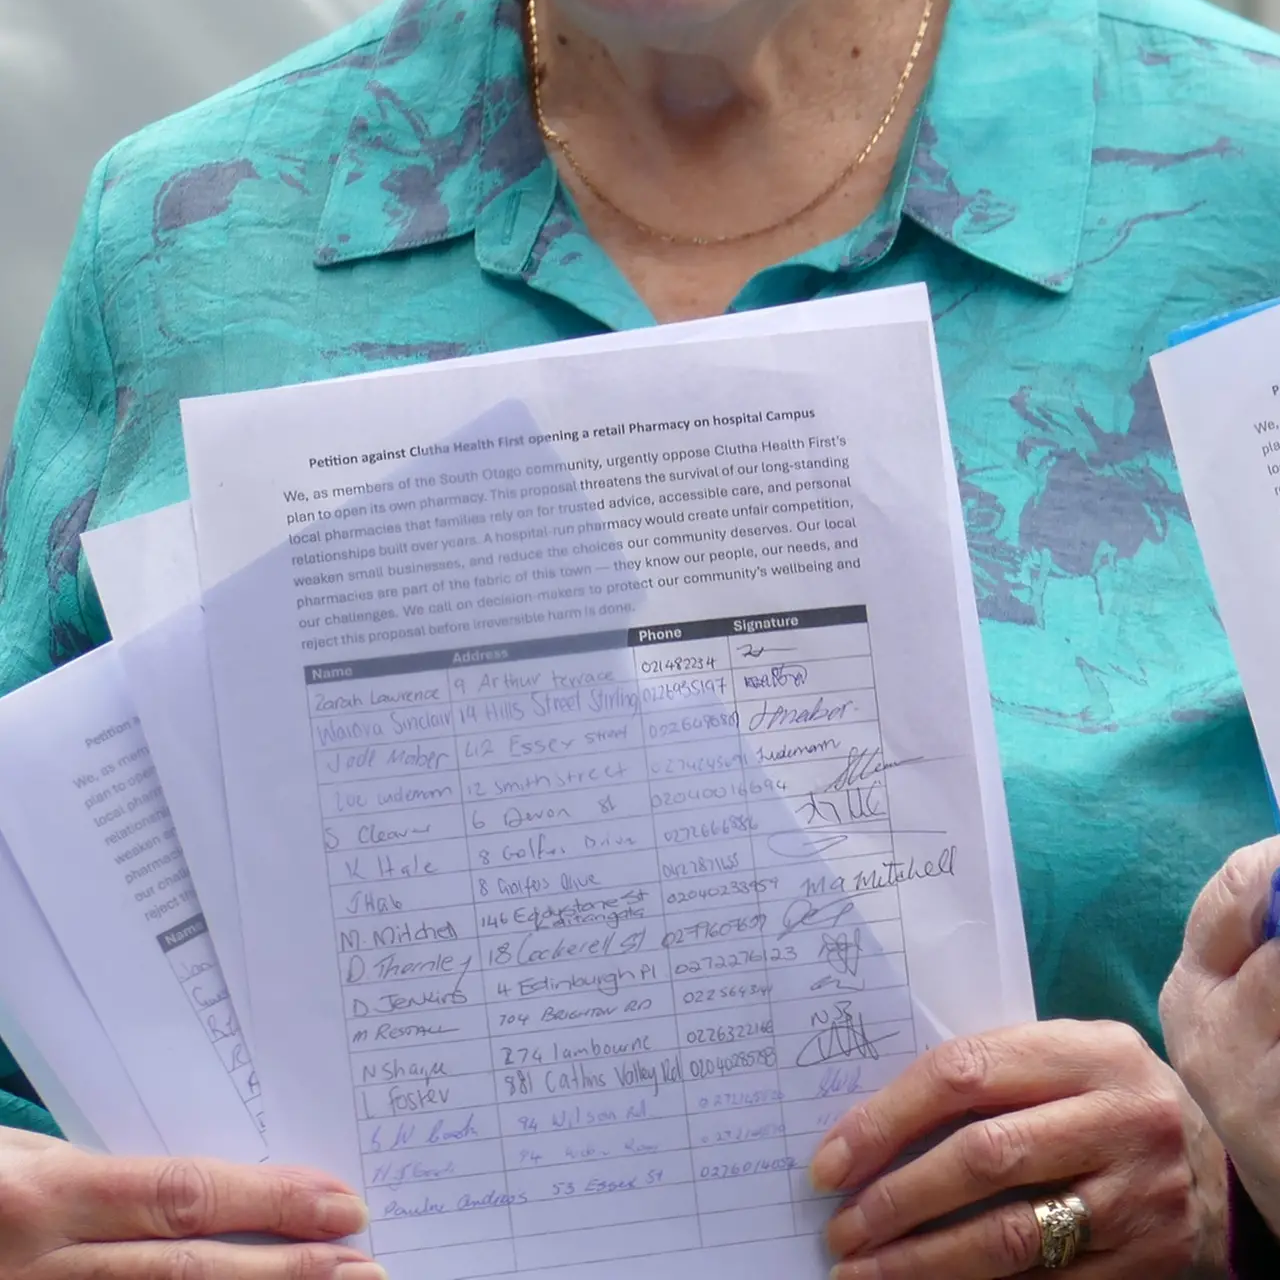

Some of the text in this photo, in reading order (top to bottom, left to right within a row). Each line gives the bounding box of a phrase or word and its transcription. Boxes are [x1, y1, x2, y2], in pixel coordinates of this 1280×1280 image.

[308, 410, 815, 468] Petition against Clutha Health First opening a retail Pharmacy on hospital Campus
[1253, 419, 1279, 434] We,
[282, 435, 846, 502] We, as members of the South Otago community, urgently oppose Clutha Health First's
[312, 615, 799, 681] Name Address Phone Signature
